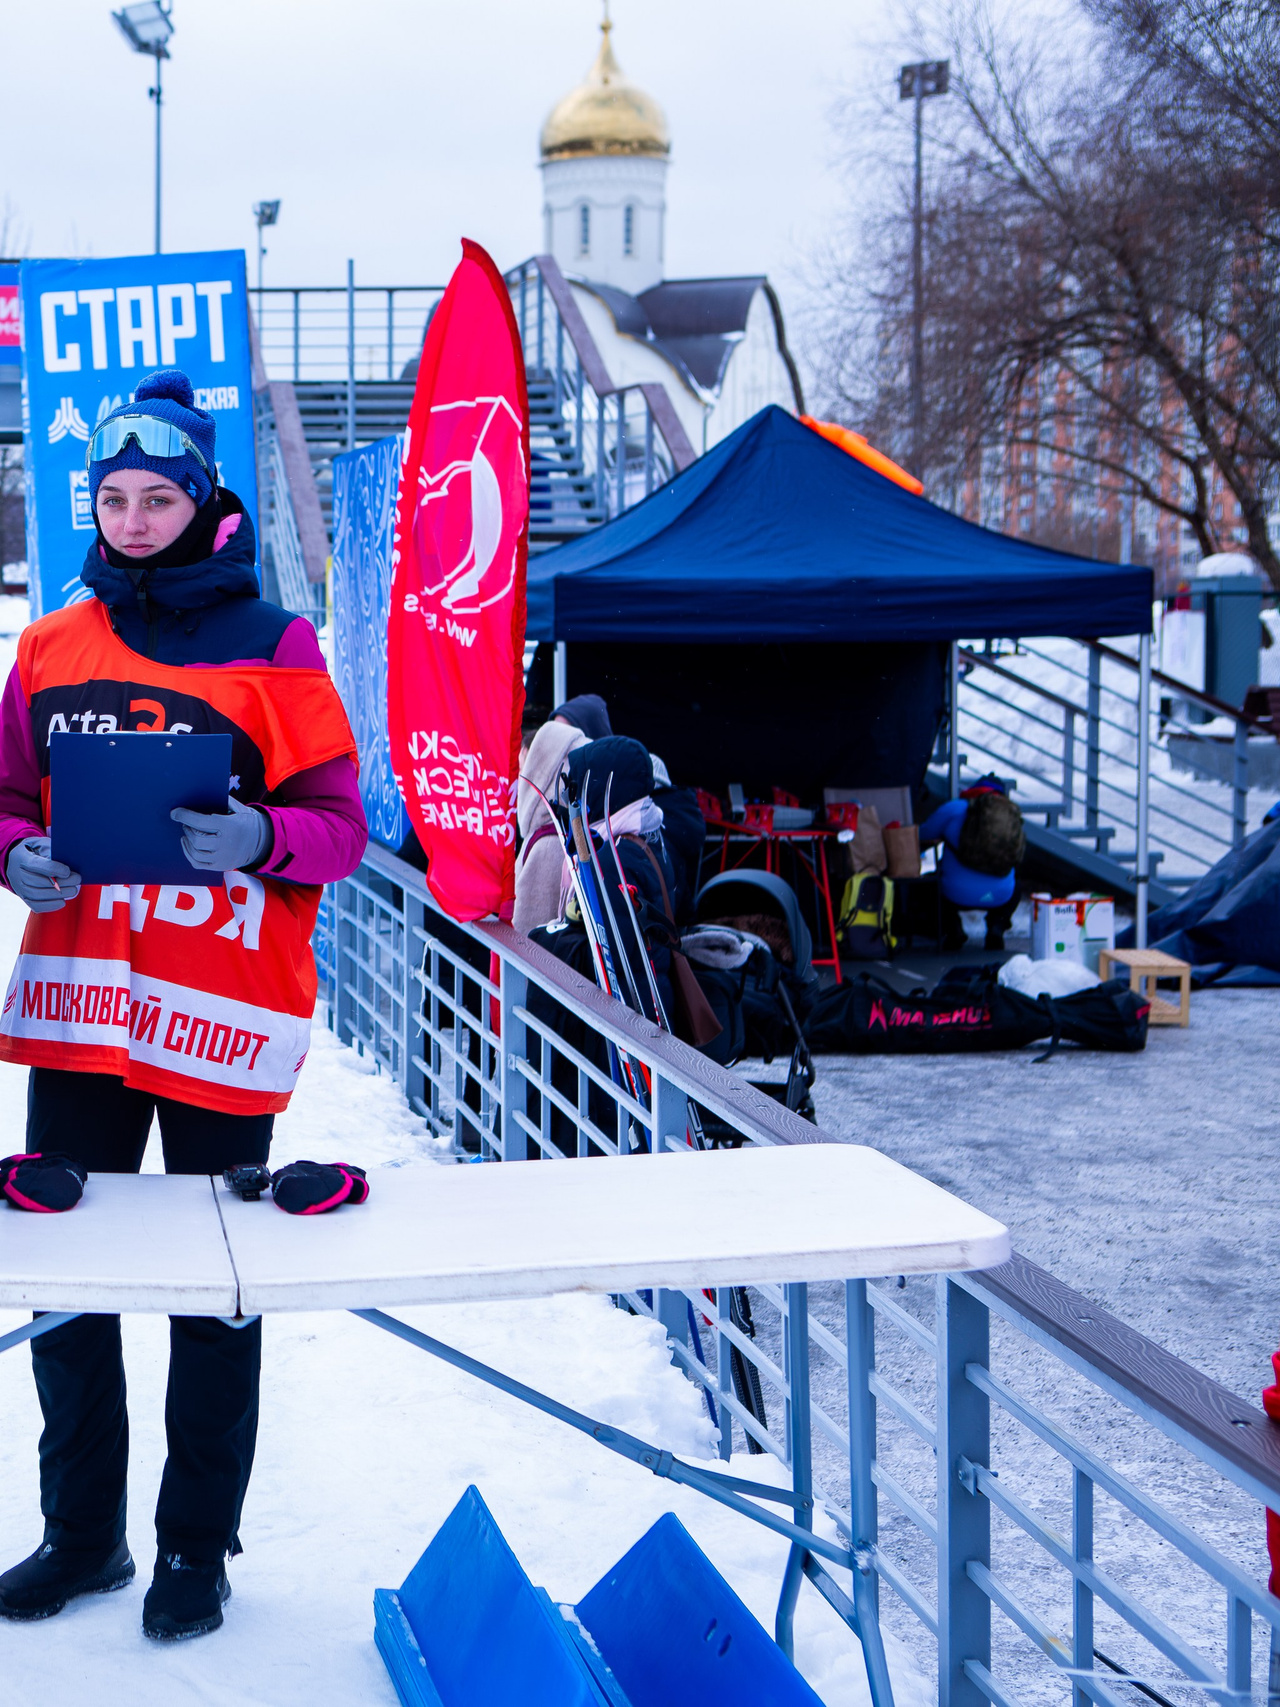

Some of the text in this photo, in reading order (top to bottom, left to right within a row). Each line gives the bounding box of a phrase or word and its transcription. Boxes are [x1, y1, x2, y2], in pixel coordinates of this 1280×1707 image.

[40, 280, 233, 373] СТАРТ
[97, 870, 267, 951] ДЬЯ
[21, 980, 270, 1071] МОСКОВСИЙ СПОРТ
